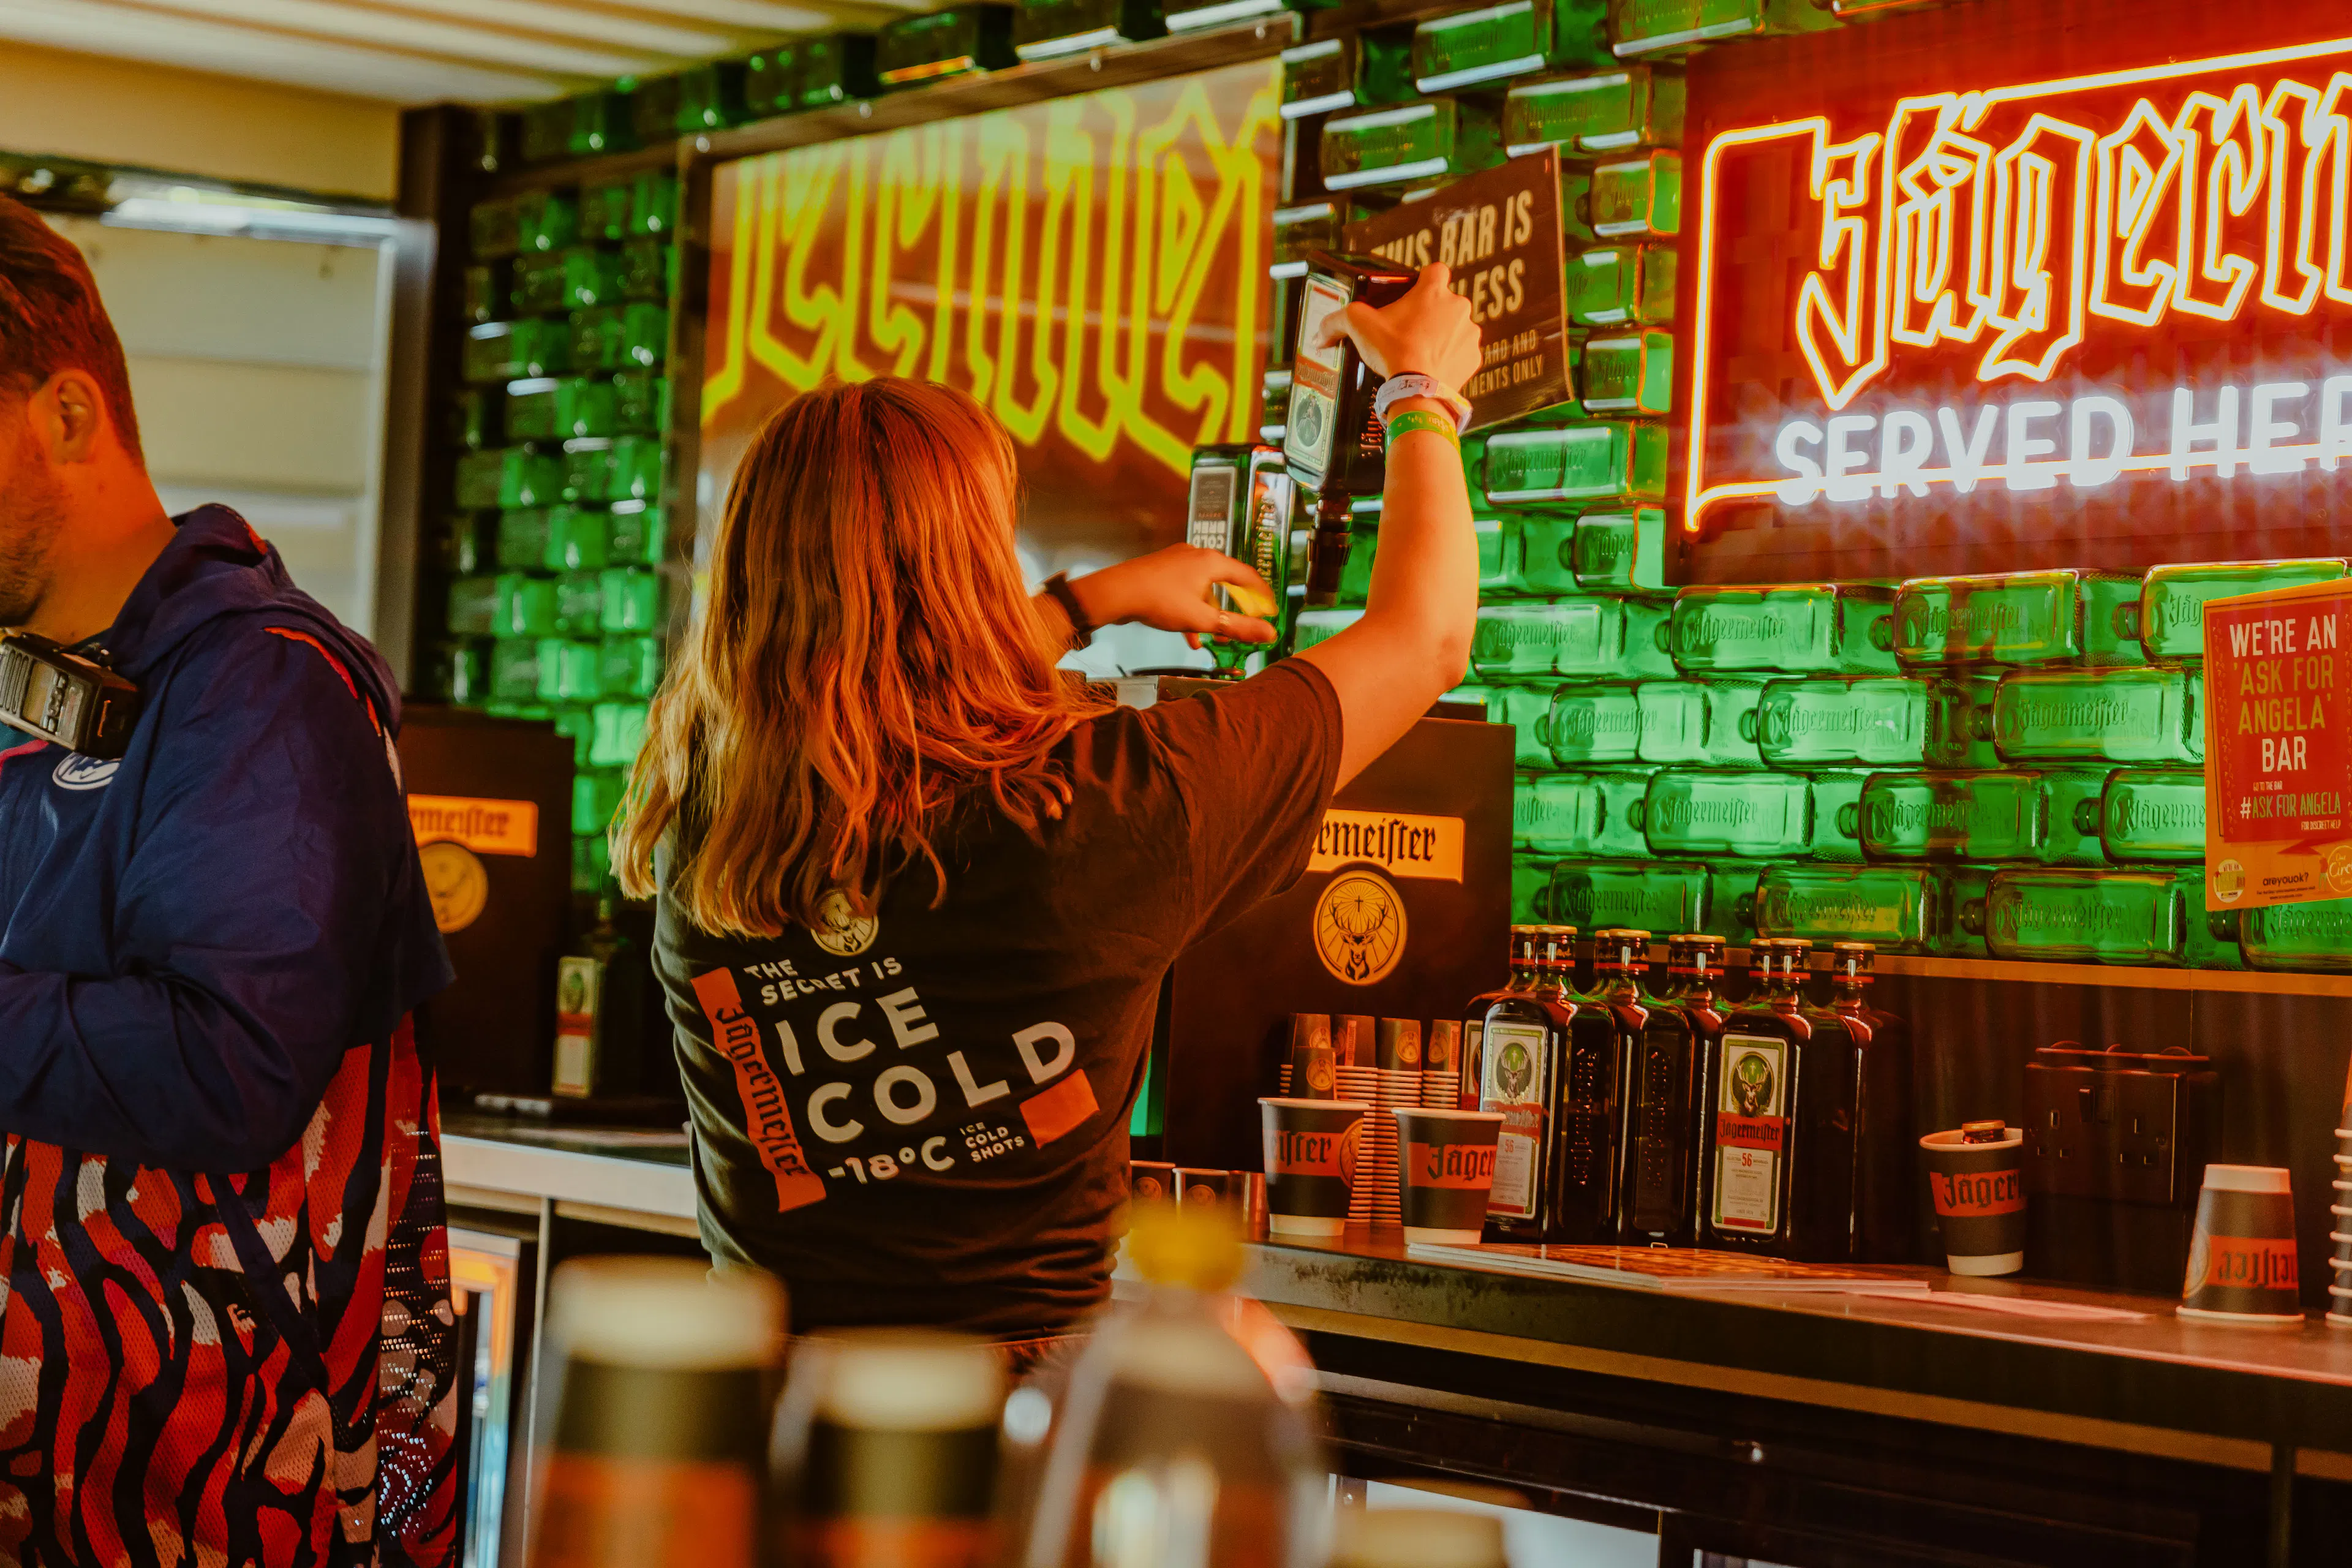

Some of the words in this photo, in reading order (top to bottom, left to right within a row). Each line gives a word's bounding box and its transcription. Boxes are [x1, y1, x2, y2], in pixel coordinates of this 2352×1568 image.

[1440, 204, 1498, 271] BAR
[1503, 189, 1534, 251] IS
[1448, 258, 1526, 323] ESS
[1480, 339, 1509, 366] ARD
[1512, 330, 1539, 356] AND
[1513, 354, 1543, 383] ONLY
[1776, 395, 2134, 506] SERVED
[1193, 533, 1224, 549] COLD
[2230, 619, 2296, 658] WE'RE
[2307, 614, 2337, 651] AN
[2294, 655, 2334, 691] FOR
[2262, 736, 2307, 772] BAR
[2240, 795, 2273, 820] #ASK
[2276, 793, 2296, 817] FOR
[2300, 791, 2341, 816] ANGELA
[1313, 818, 1436, 867] rmeister
[2263, 872, 2309, 887] areyouok?
[744, 959, 798, 979] THE
[761, 967, 861, 1006] SECRET
[872, 957, 903, 979] IS
[775, 987, 940, 1076] ICE
[715, 1005, 809, 1176] Jägermeister
[807, 1021, 1076, 1143] COLD
[960, 1122, 987, 1135] ICE
[965, 1126, 1009, 1149] COLD
[1719, 1118, 1781, 1144] Jägermeister
[970, 1135, 1025, 1163] SHOTS
[1741, 1152, 1753, 1167] 56
[1943, 1172, 2021, 1210] Jäger
